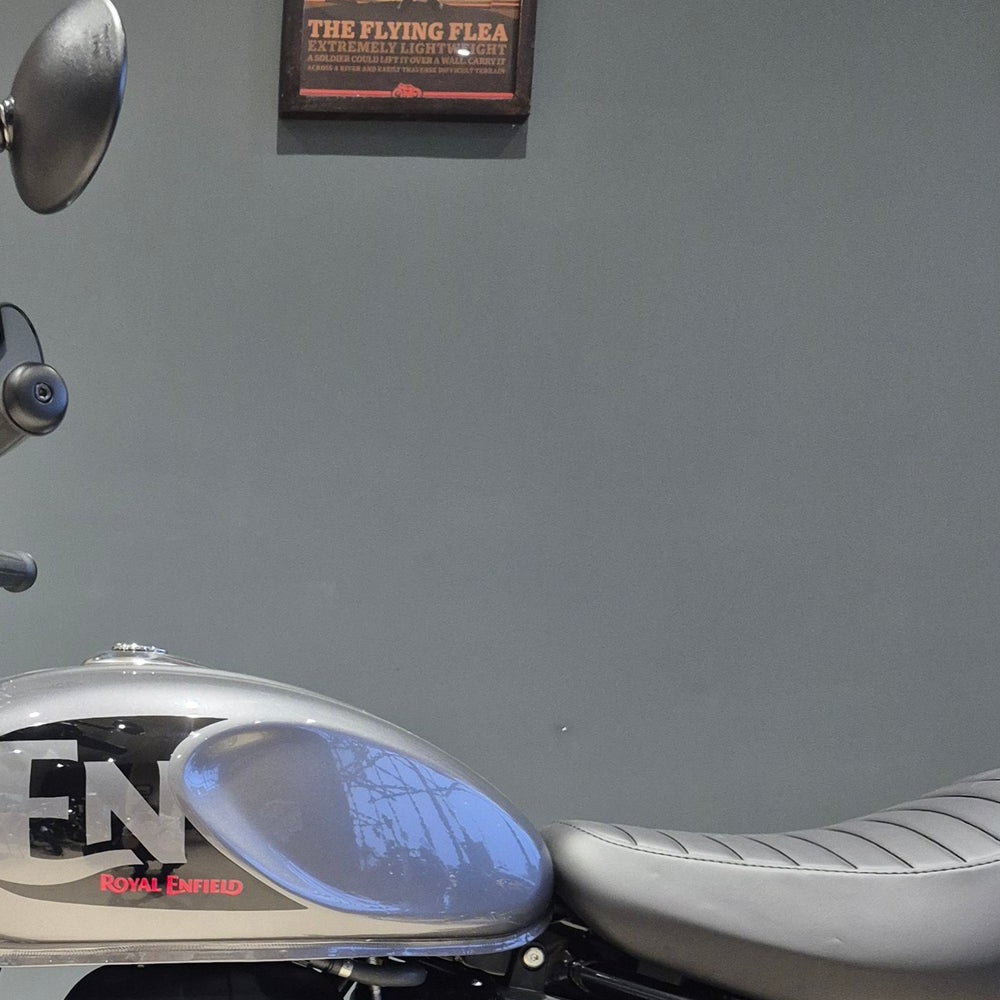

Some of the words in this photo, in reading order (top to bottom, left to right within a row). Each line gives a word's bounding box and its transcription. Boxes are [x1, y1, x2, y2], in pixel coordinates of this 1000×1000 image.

[308, 20, 355, 39] THE
[359, 20, 444, 41] FLYING
[448, 22, 508, 42] FLEA
[308, 40, 397, 53] EXTREMELY
[401, 42, 507, 56] LIGHTWEIGHT
[307, 55, 313, 63] A
[314, 55, 350, 63] SOLDIER
[351, 55, 379, 64] COULD
[380, 56, 398, 64] LIFT
[400, 56, 408, 64] IT
[410, 56, 433, 65] OVER
[433, 57, 440, 65] A
[467, 57, 495, 66] CARRY
[496, 57, 507, 66] IT
[100, 873, 161, 895] ROYAL
[166, 875, 244, 897] ENFIELD
